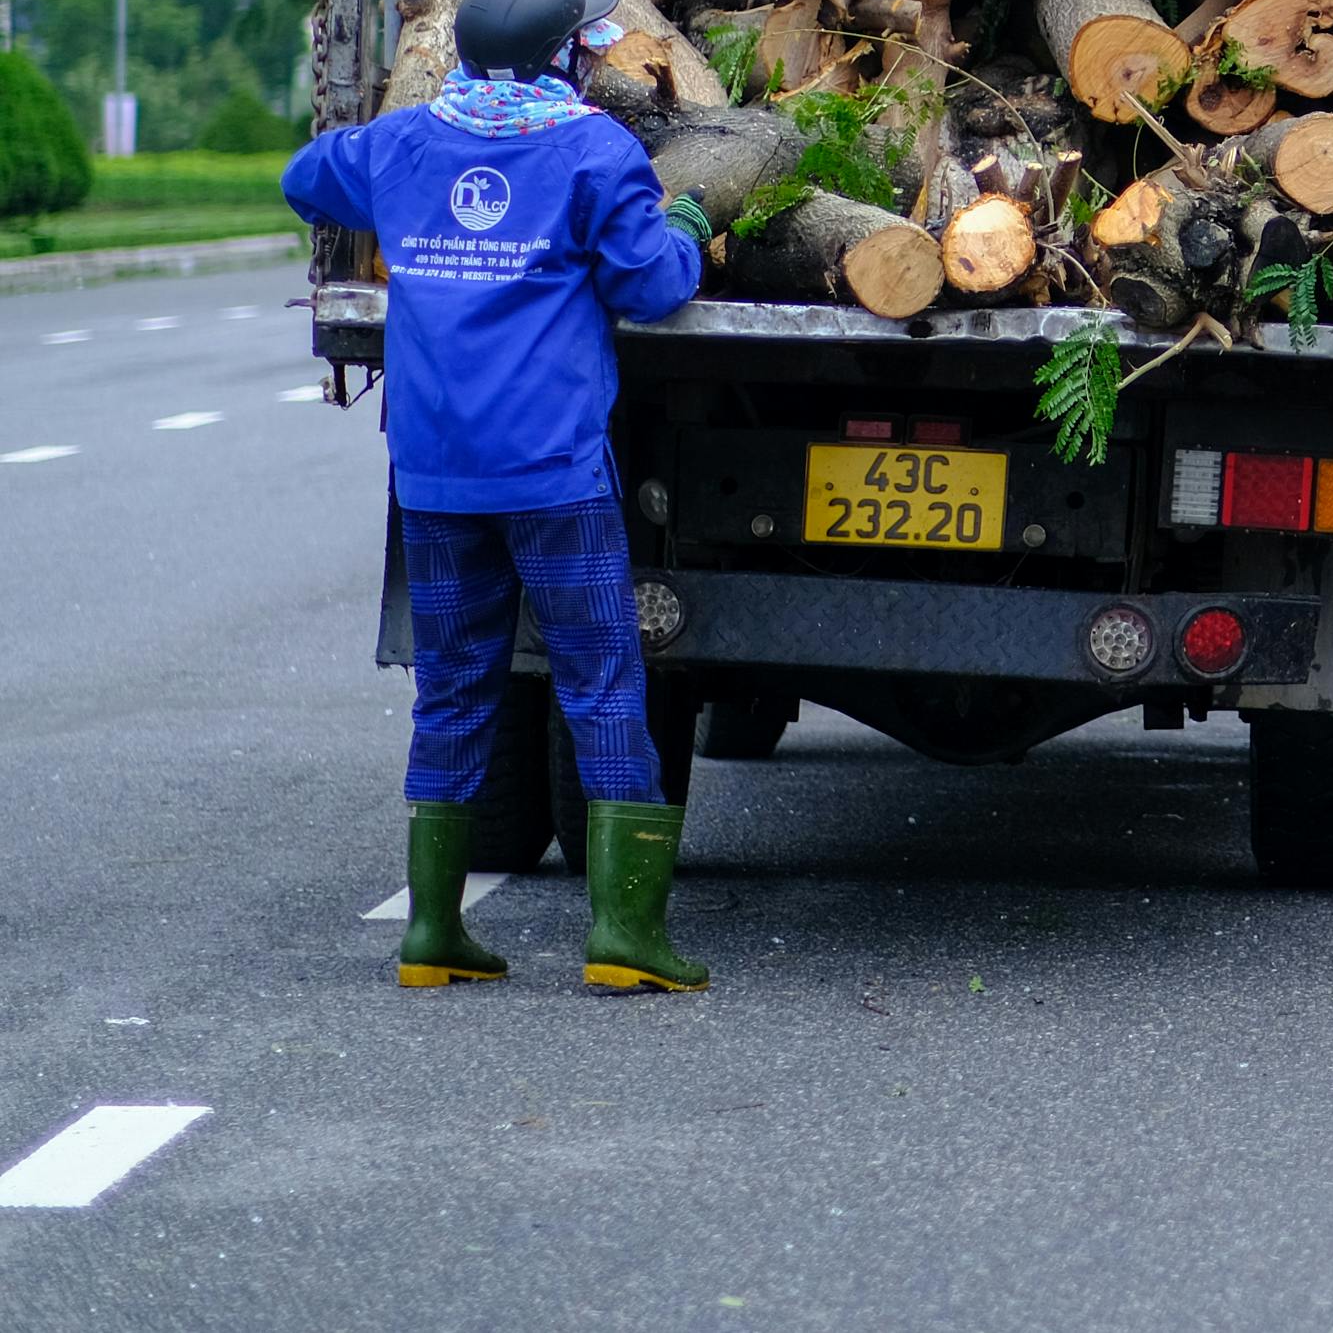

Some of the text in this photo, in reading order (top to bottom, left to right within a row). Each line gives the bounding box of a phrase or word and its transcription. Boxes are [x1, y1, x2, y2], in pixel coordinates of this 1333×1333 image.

[418, 237, 429, 248] TY
[478, 238, 499, 252] TÔNG
[864, 451, 950, 495] 43C
[826, 497, 983, 544] 232.20
